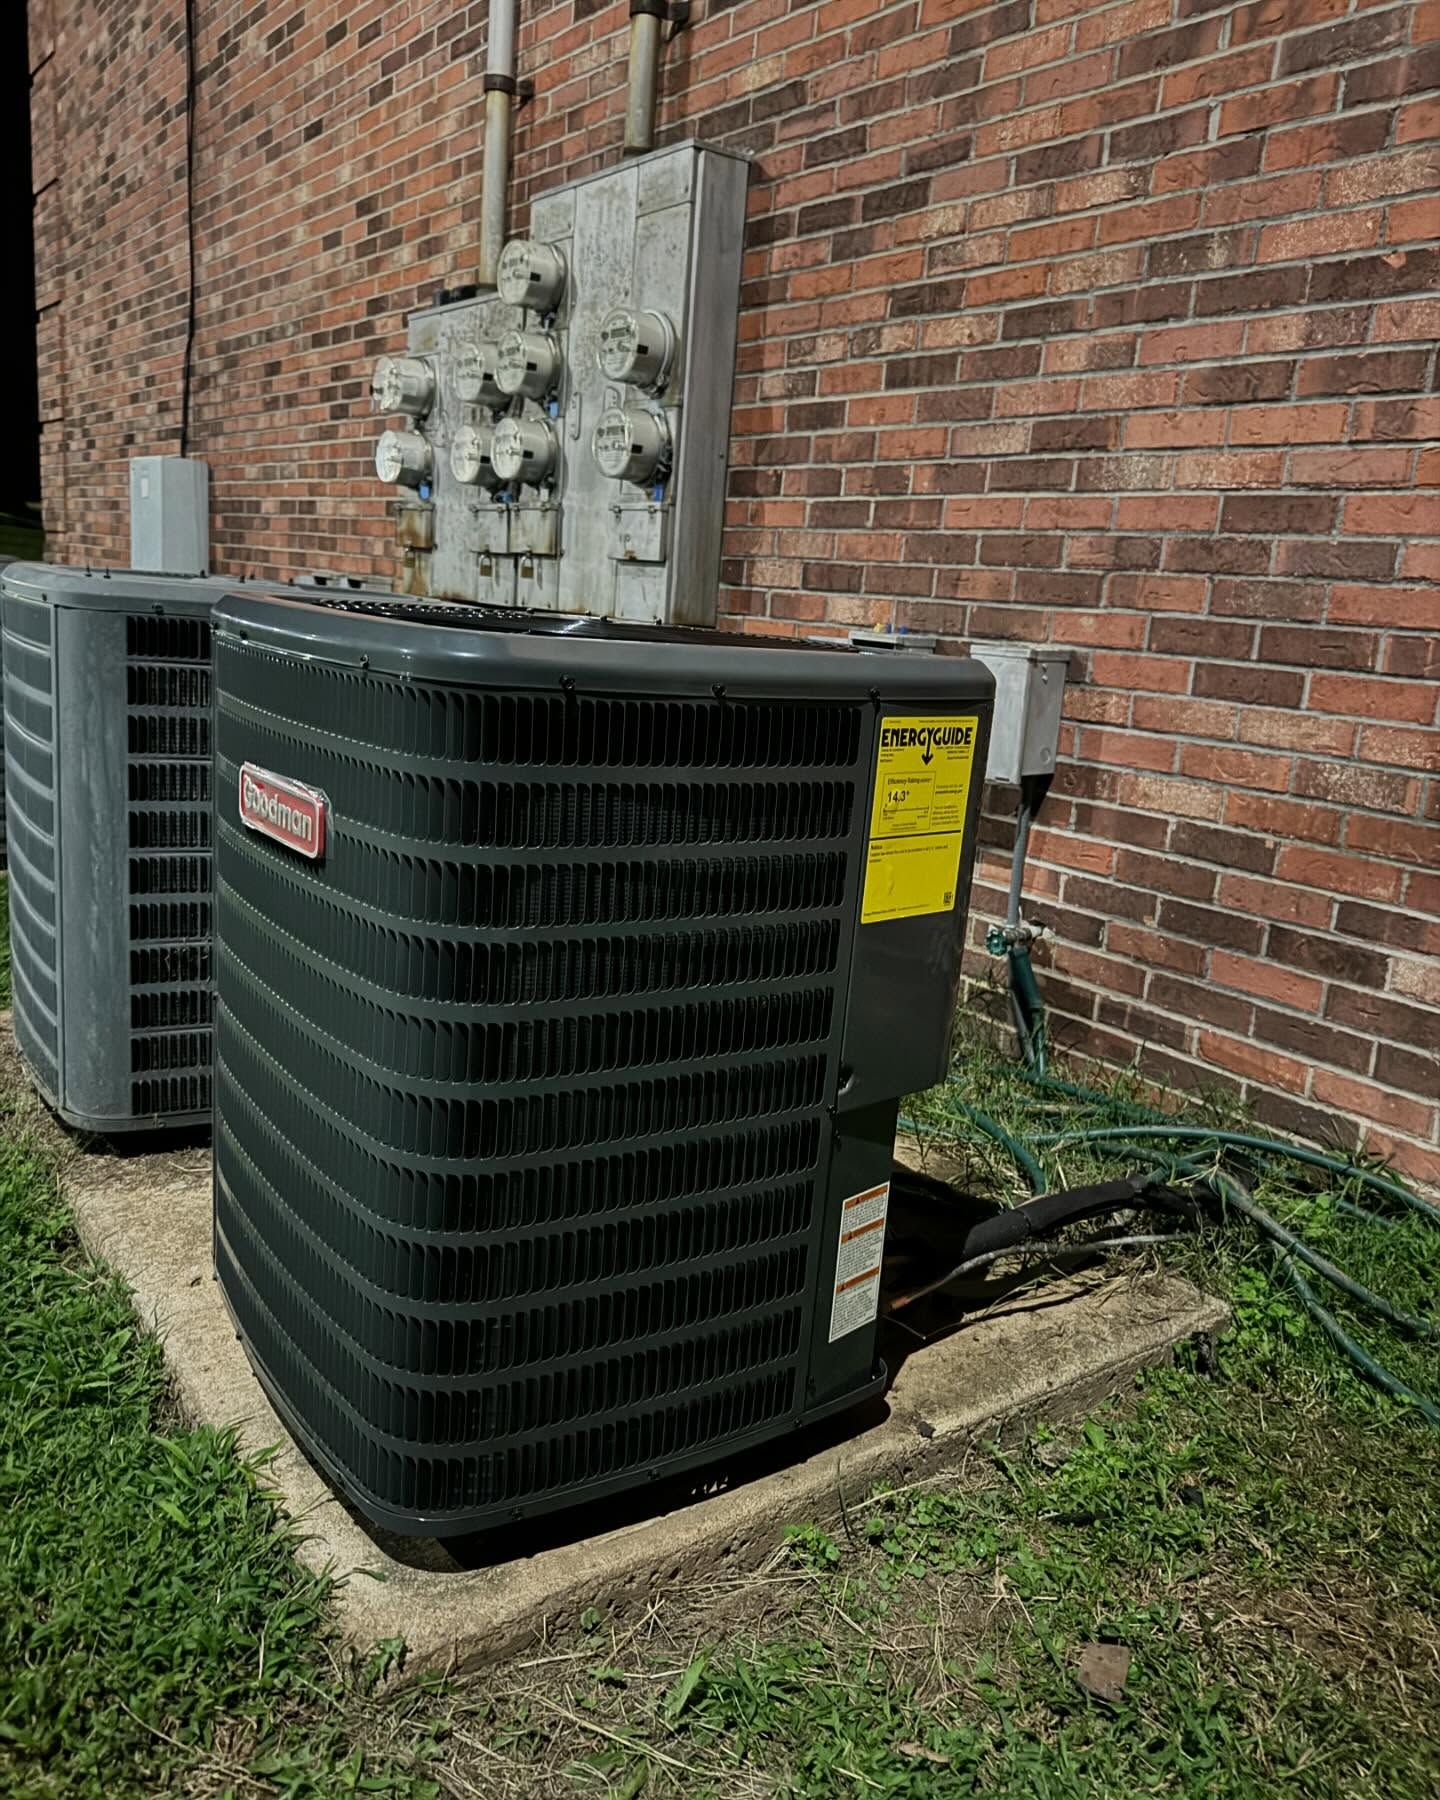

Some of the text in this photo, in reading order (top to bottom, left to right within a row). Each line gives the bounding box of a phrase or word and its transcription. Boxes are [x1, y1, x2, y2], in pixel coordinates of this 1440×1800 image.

[881, 727, 974, 747] ENERGYGUIDE
[887, 777, 907, 786] Efficiency
[908, 776, 920, 785] Rating
[243, 776, 312, 842] Goodman
